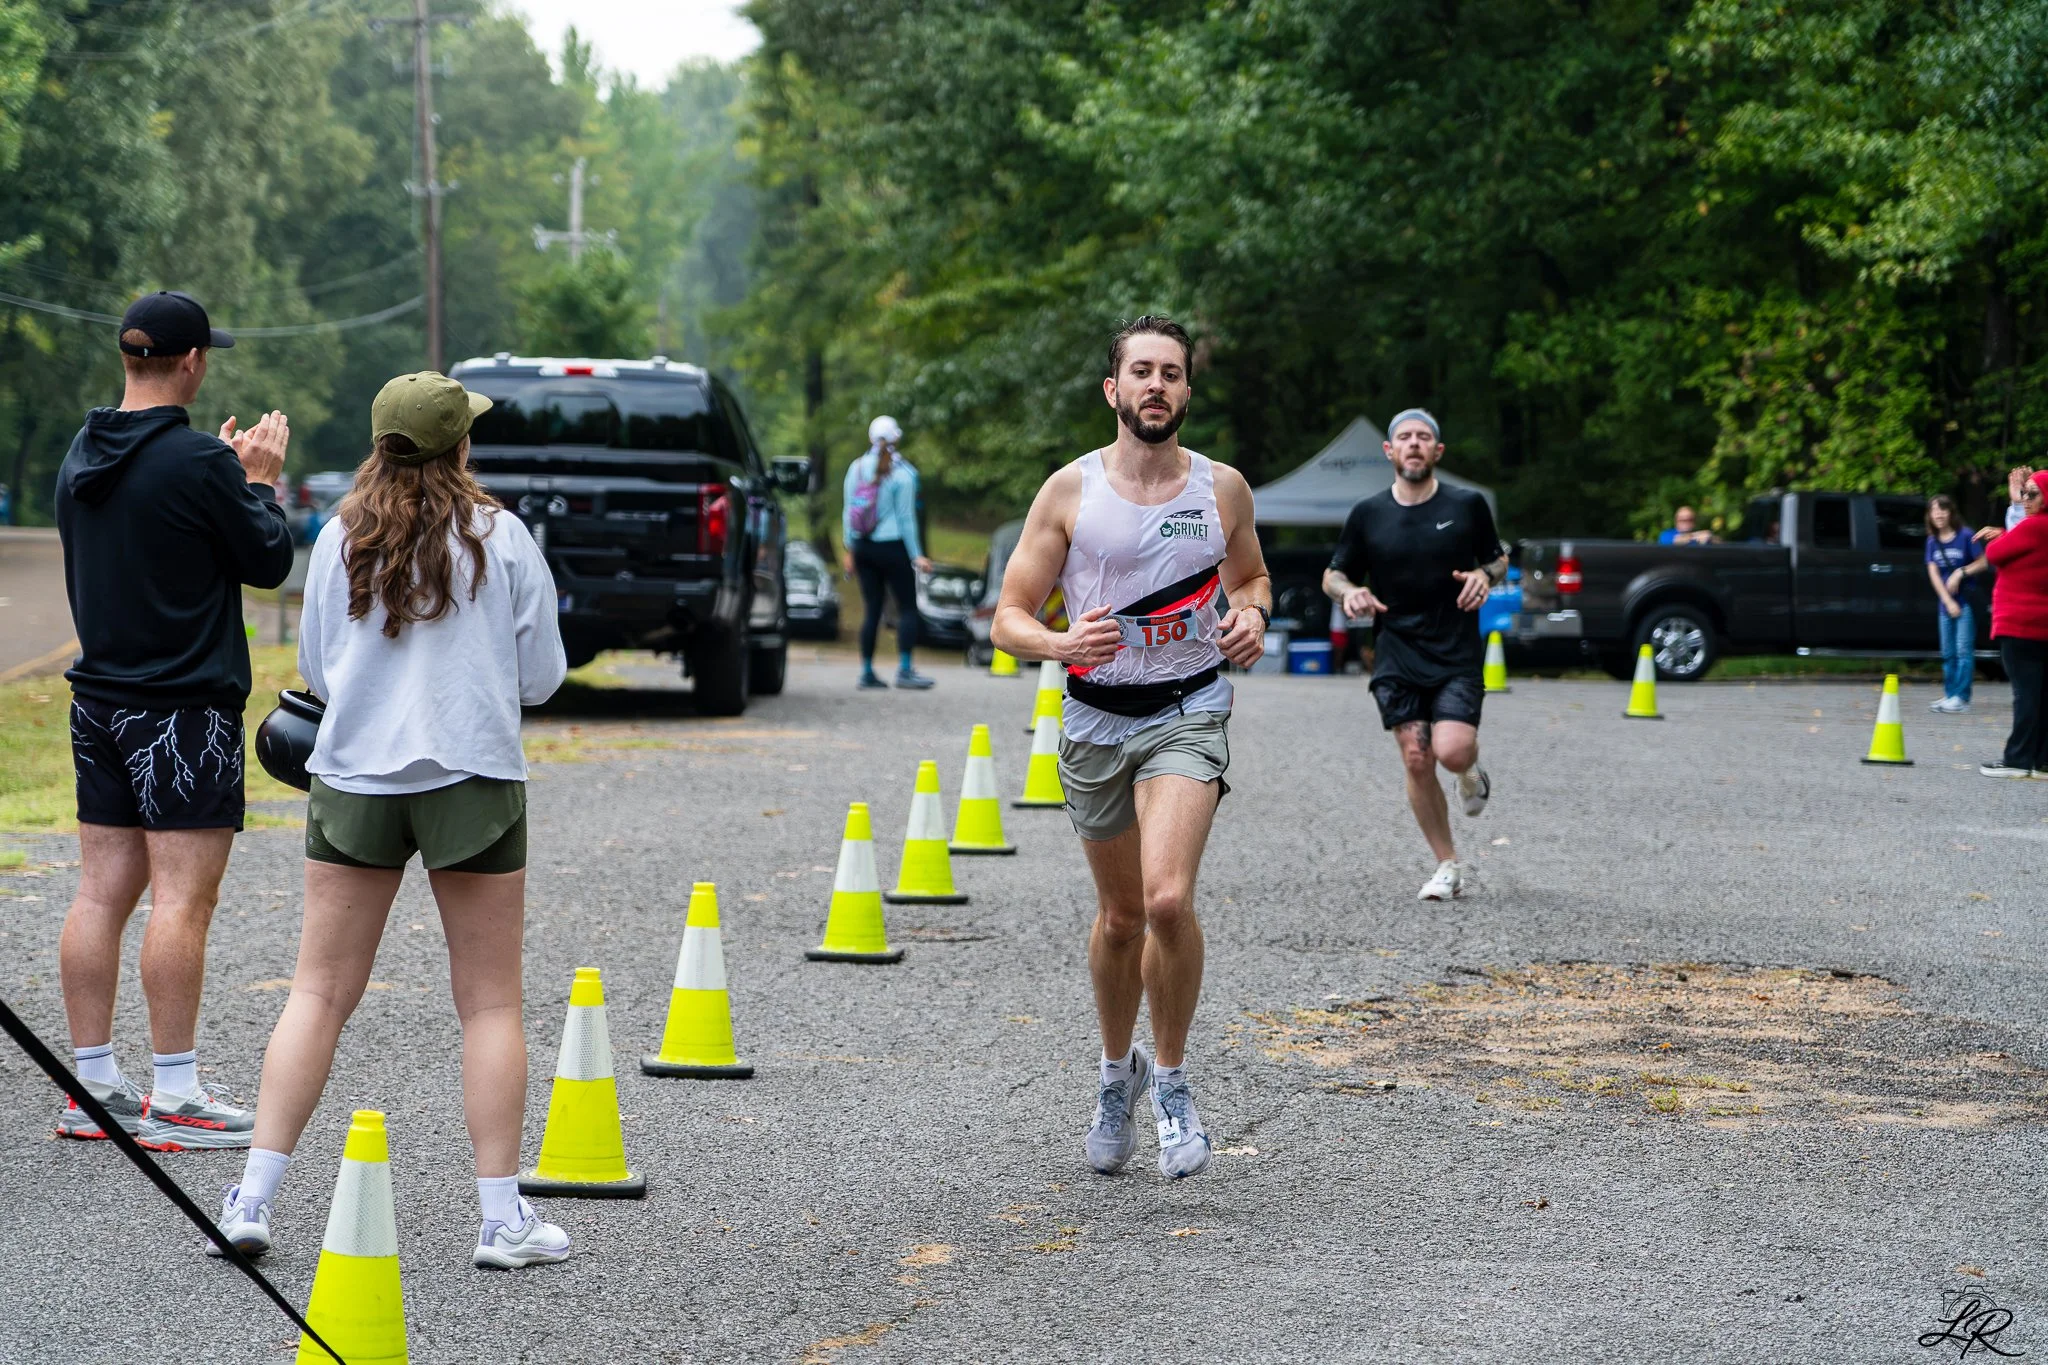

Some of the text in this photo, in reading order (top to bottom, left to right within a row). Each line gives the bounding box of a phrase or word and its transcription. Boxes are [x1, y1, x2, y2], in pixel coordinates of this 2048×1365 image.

[1164, 512, 1203, 520] ALTRA
[1174, 522, 1208, 538] GRIVET
[1141, 621, 1188, 646] 150
[157, 1114, 227, 1130] ALTRA
